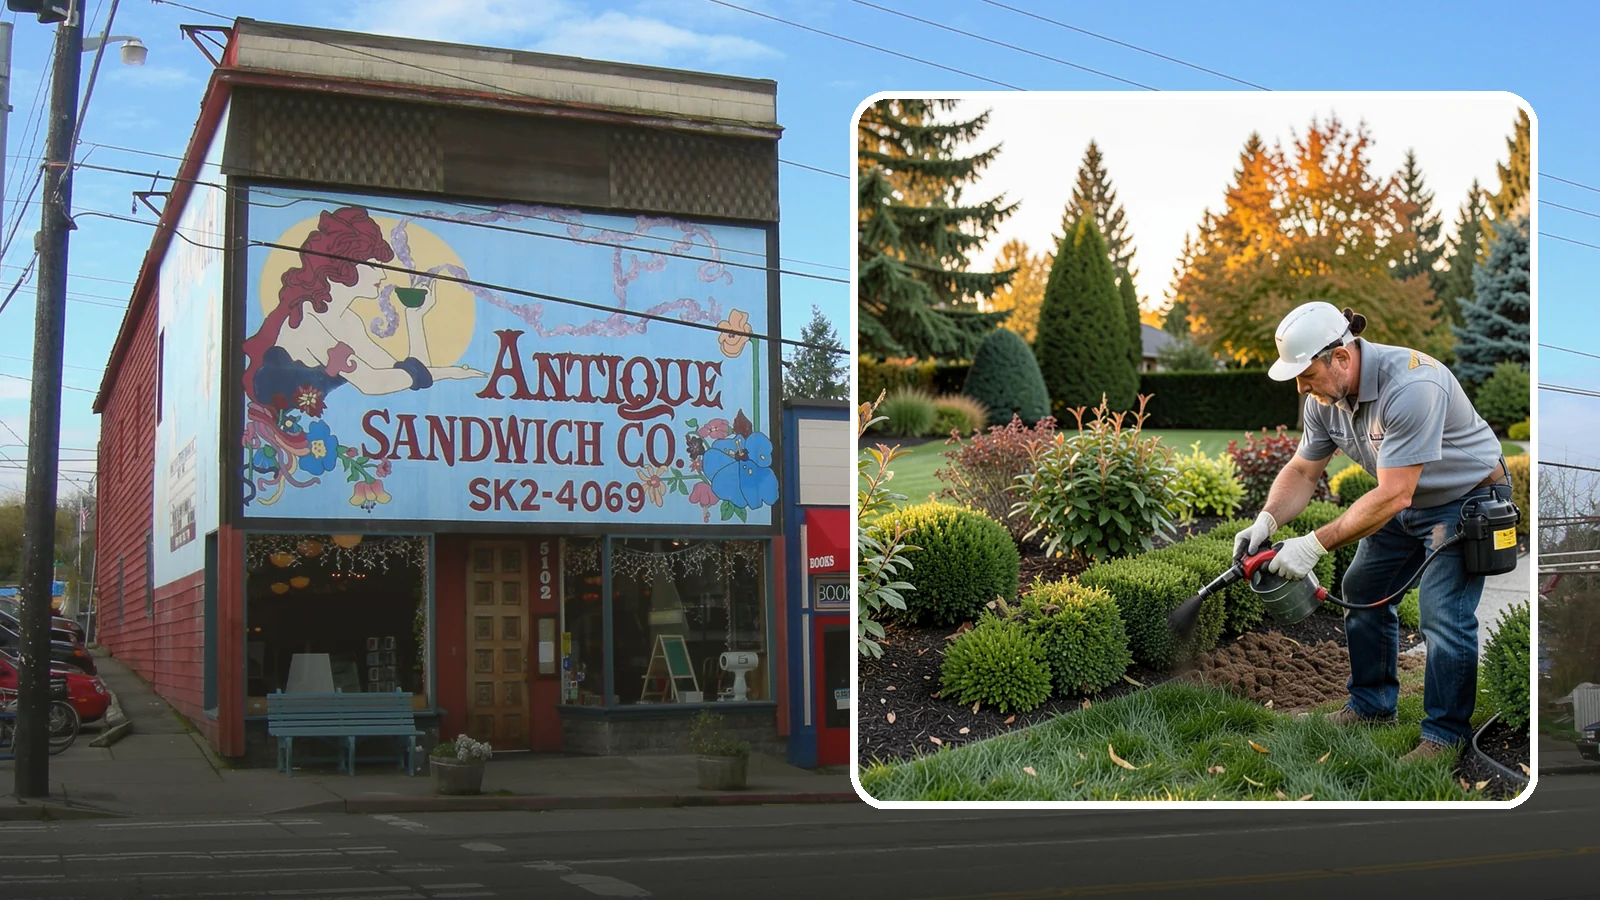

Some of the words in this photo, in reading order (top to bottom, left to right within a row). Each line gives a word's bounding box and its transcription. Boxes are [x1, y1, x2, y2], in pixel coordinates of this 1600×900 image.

[475, 329, 724, 421] ANTIQUE
[361, 408, 605, 467] SANDWICH
[617, 421, 685, 469] CO.
[468, 477, 646, 513] SK2-4069
[540, 541, 552, 600] 5102
[809, 555, 835, 569] BOOKS
